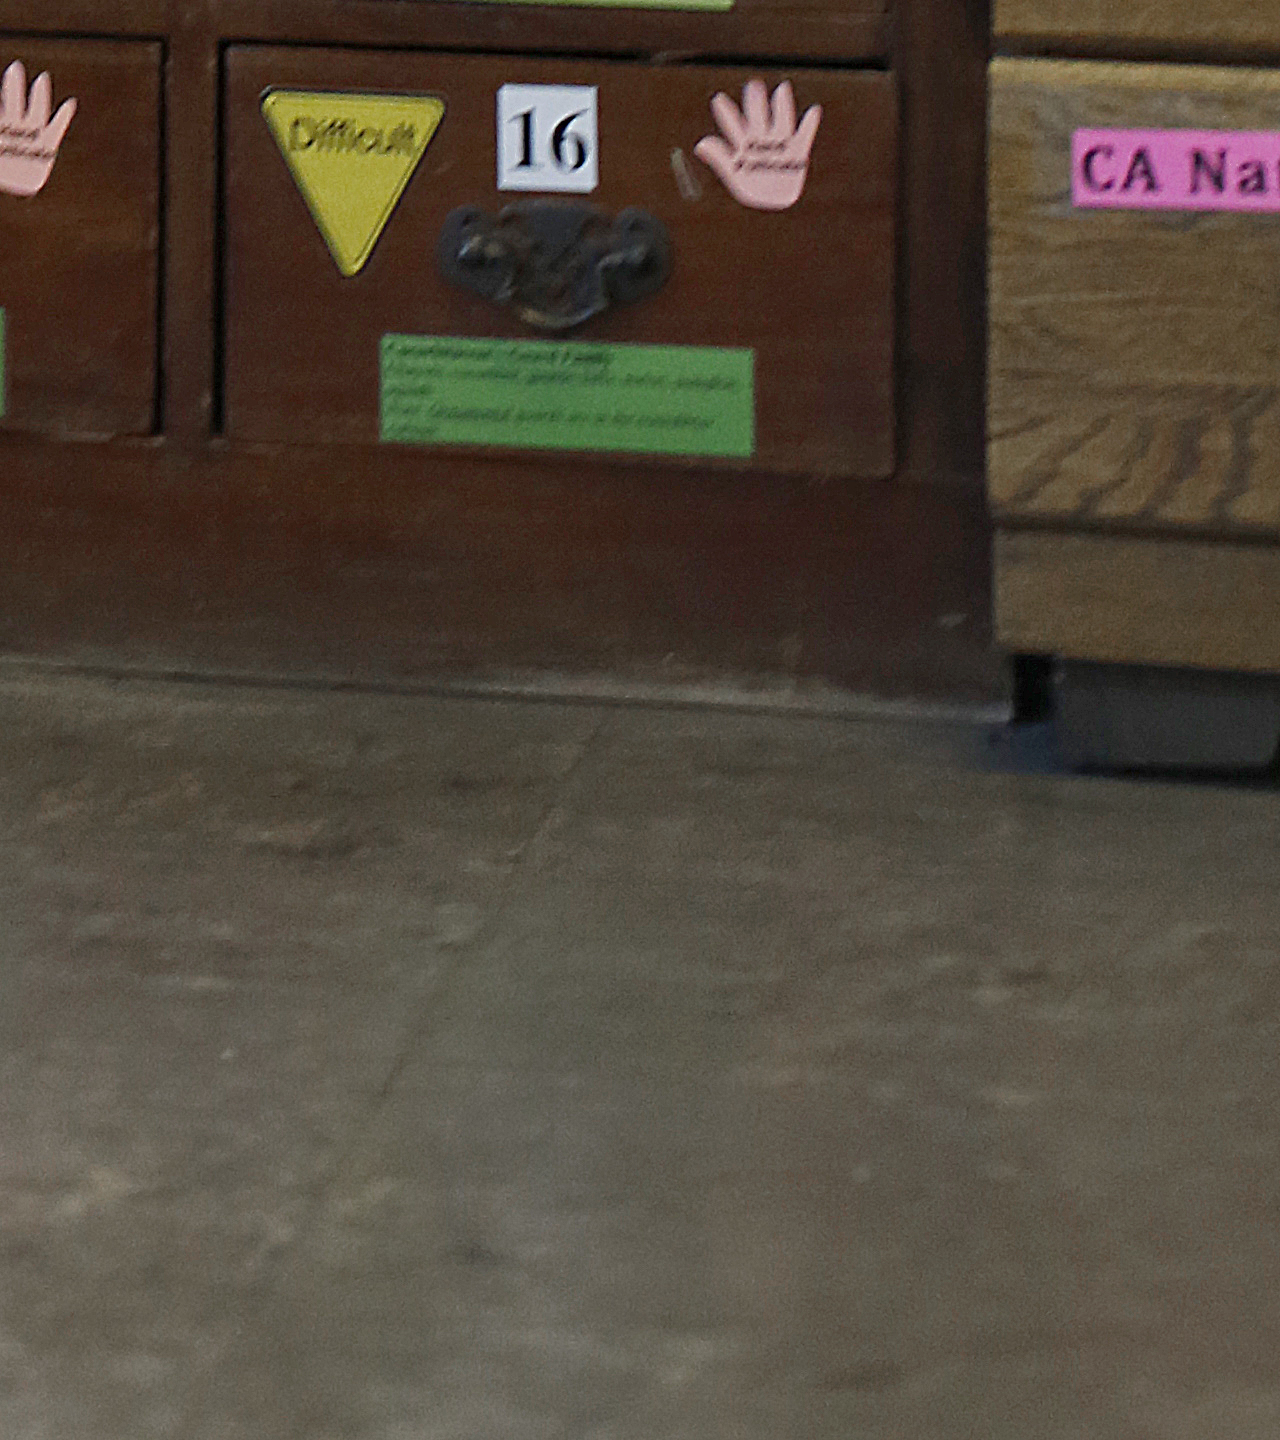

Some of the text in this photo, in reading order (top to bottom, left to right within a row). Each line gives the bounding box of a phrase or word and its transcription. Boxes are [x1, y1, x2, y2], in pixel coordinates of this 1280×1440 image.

[289, 115, 416, 157] Difficult
[506, 105, 591, 174] 16
[1080, 142, 1161, 194] CA
